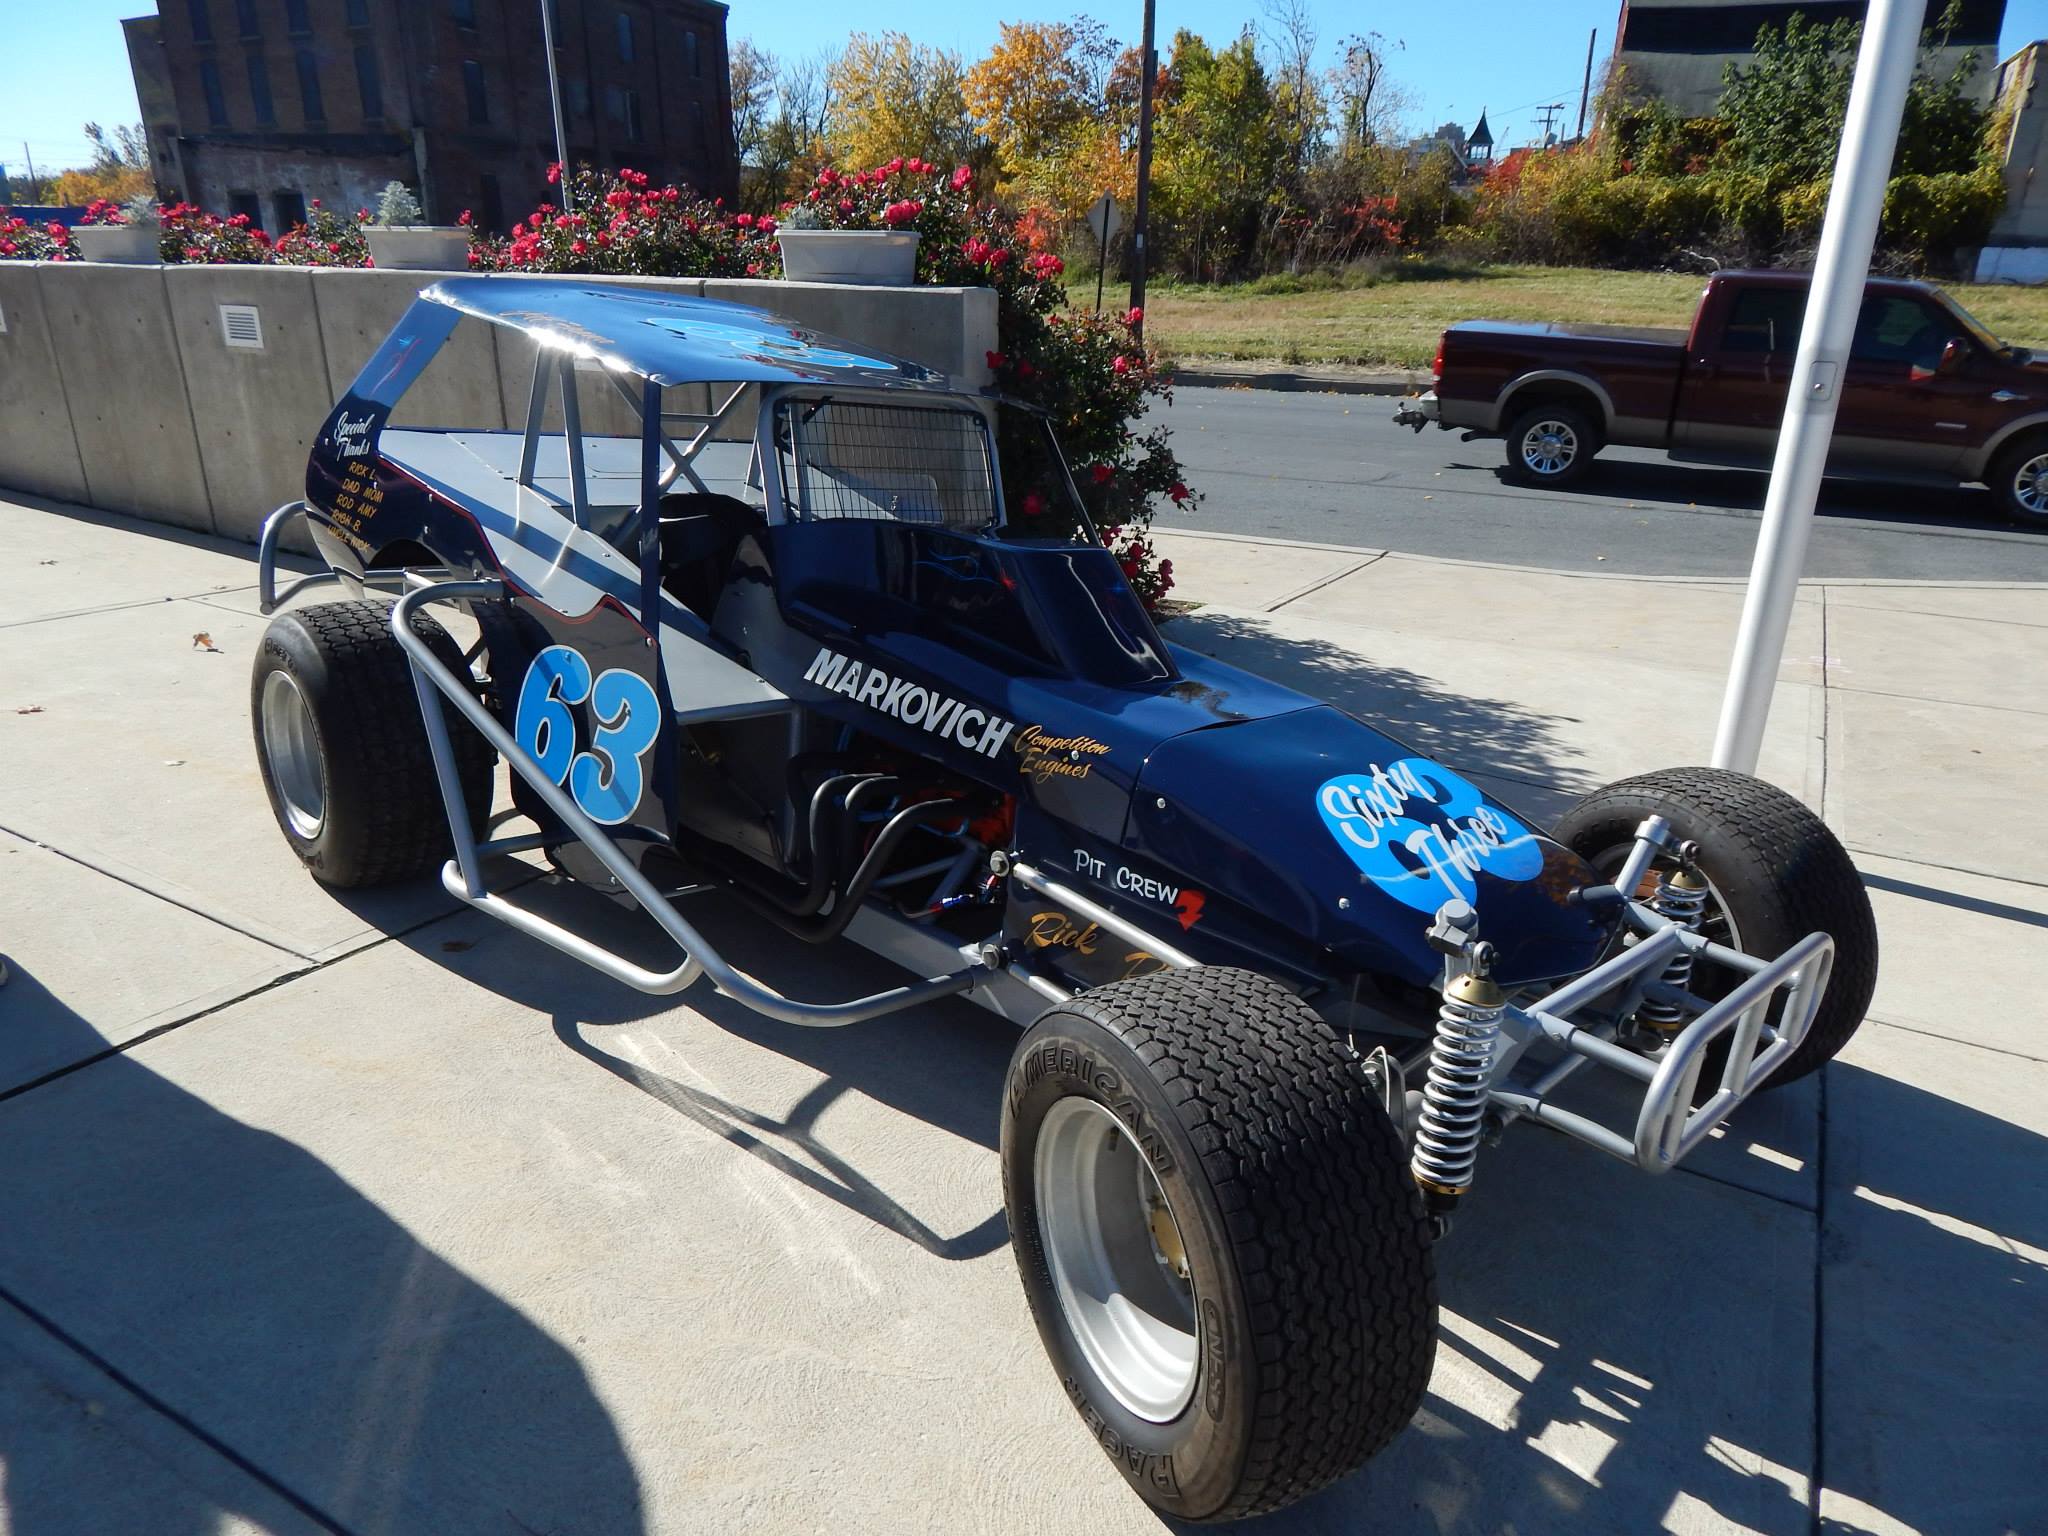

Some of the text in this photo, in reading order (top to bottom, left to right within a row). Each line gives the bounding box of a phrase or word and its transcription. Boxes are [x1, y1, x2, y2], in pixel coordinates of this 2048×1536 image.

[333, 411, 375, 440] Special
[336, 437, 370, 462] Thanks
[335, 493, 378, 519] ROD AMY
[342, 478, 385, 503] DAD MOM
[803, 647, 1015, 759] MARKOVICH
[514, 644, 662, 826] 63
[1019, 747, 1092, 784] Engines
[1321, 763, 1439, 849] Sixty
[1073, 848, 1180, 905] PIT CREW
[1404, 806, 1509, 901] Three
[1023, 911, 1099, 955] Rick
[1009, 1046, 1174, 1175] AMERICAN
